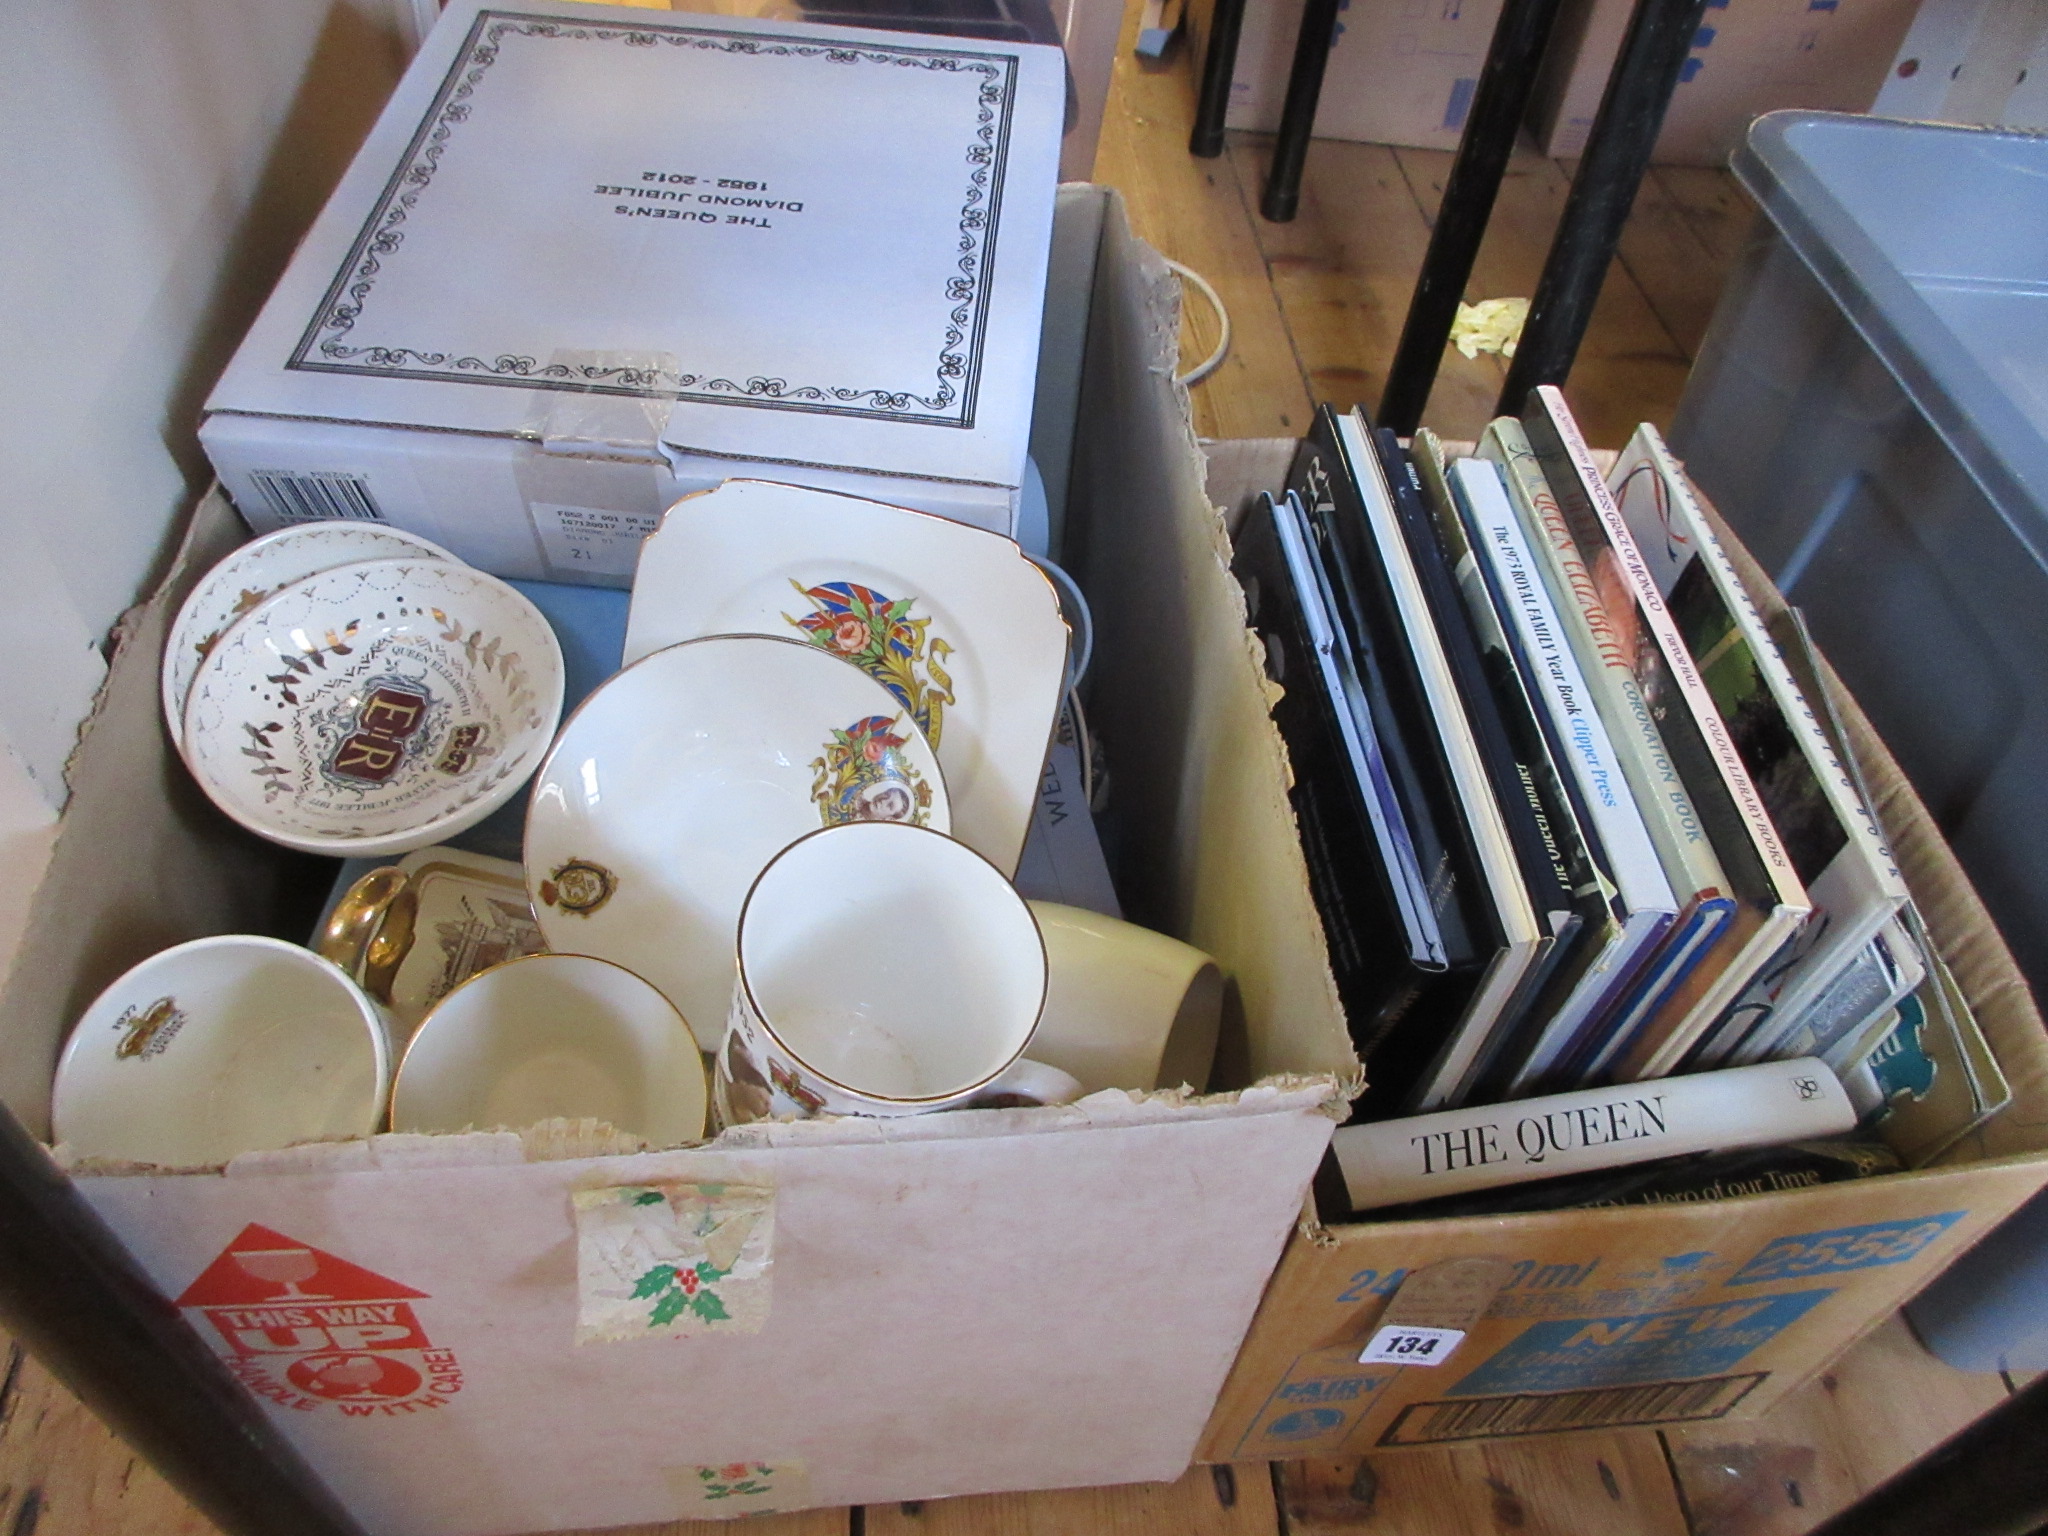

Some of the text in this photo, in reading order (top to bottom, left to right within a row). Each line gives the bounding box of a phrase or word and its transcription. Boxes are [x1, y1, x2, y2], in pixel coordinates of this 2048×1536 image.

[641, 171, 698, 185] 2012
[717, 178, 768, 191] 1952
[594, 184, 804, 212] DIAMOND JUBILEE
[614, 204, 772, 229] THE QUEEN'S
[1582, 465, 1614, 513] PRINCESS
[1604, 511, 1633, 549] GRACE
[1624, 547, 1640, 566] OF
[1533, 492, 1629, 668] QUEEN ELIZABETH
[1628, 562, 1663, 612] MONACO
[391, 646, 429, 664] QUEEN
[429, 656, 471, 708] ELIZABETH
[1492, 526, 1617, 808] The 1973 ROYAL FAMILY Year Book Clipper Press
[1664, 632, 1698, 690] TREVOR HALL
[1622, 680, 1704, 844] CORONATION BOOK
[1704, 716, 1786, 868] COLOUR LIBRARY BOOKS
[1856, 806, 1901, 878] BOOK
[112, 1003, 137, 1030] 1977
[1411, 1094, 1668, 1176] THE QUEEN
[1702, 1178, 1722, 1201] of
[1727, 1176, 1767, 1197] our
[1763, 1169, 1822, 1191] Time
[218, 1305, 398, 1329] THIS WAY
[1563, 1299, 1777, 1348] NEW
[233, 1323, 412, 1351] UP
[1384, 1335, 1440, 1356] 134
[338, 1395, 449, 1416] WITH
